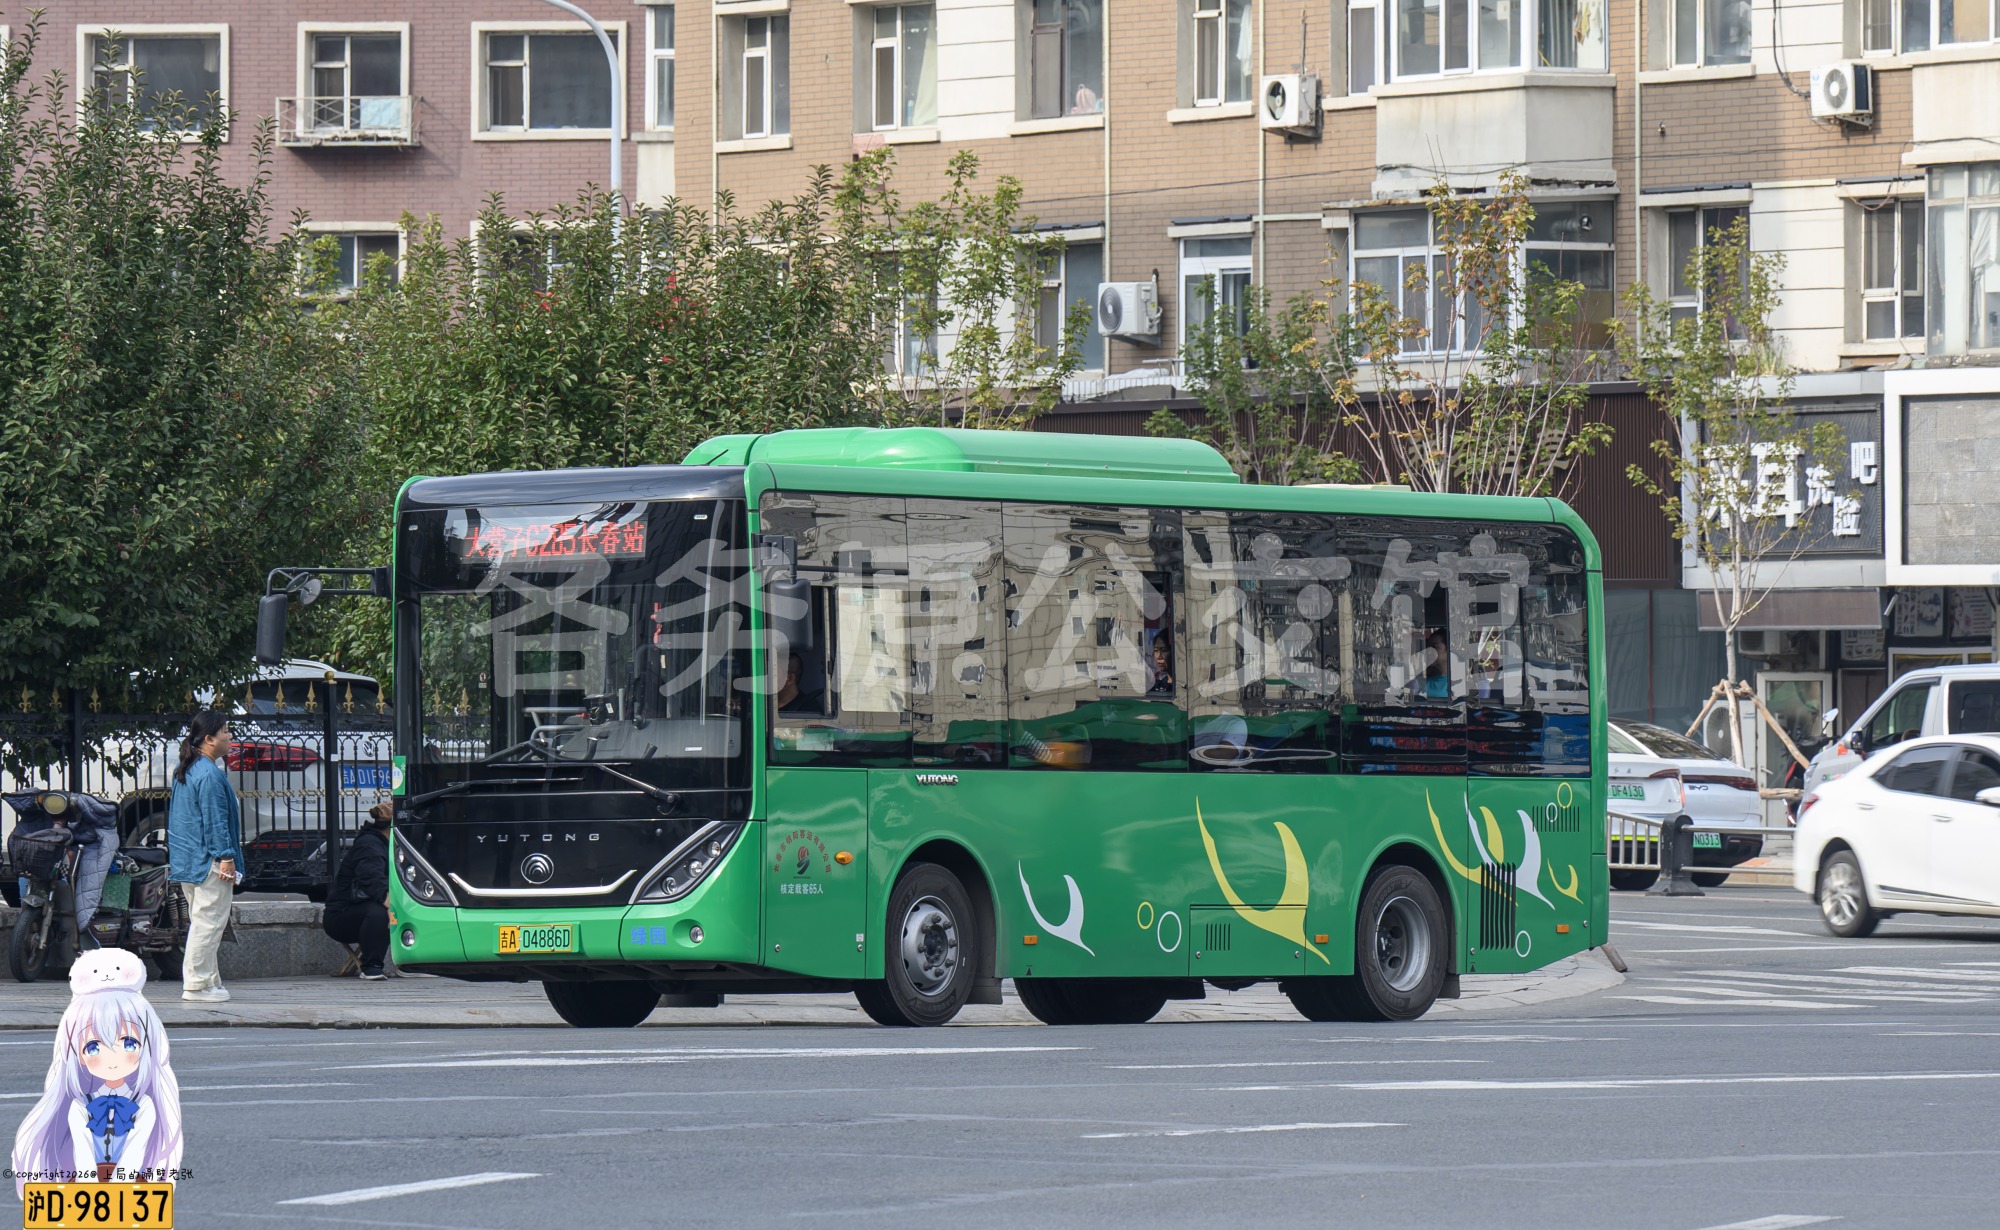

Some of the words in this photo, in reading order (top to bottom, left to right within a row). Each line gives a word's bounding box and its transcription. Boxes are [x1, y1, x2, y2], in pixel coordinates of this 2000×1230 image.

[915, 774, 959, 786] YUTONG
[477, 833, 600, 843] YUTONG
[631, 925, 667, 945] 绿园
